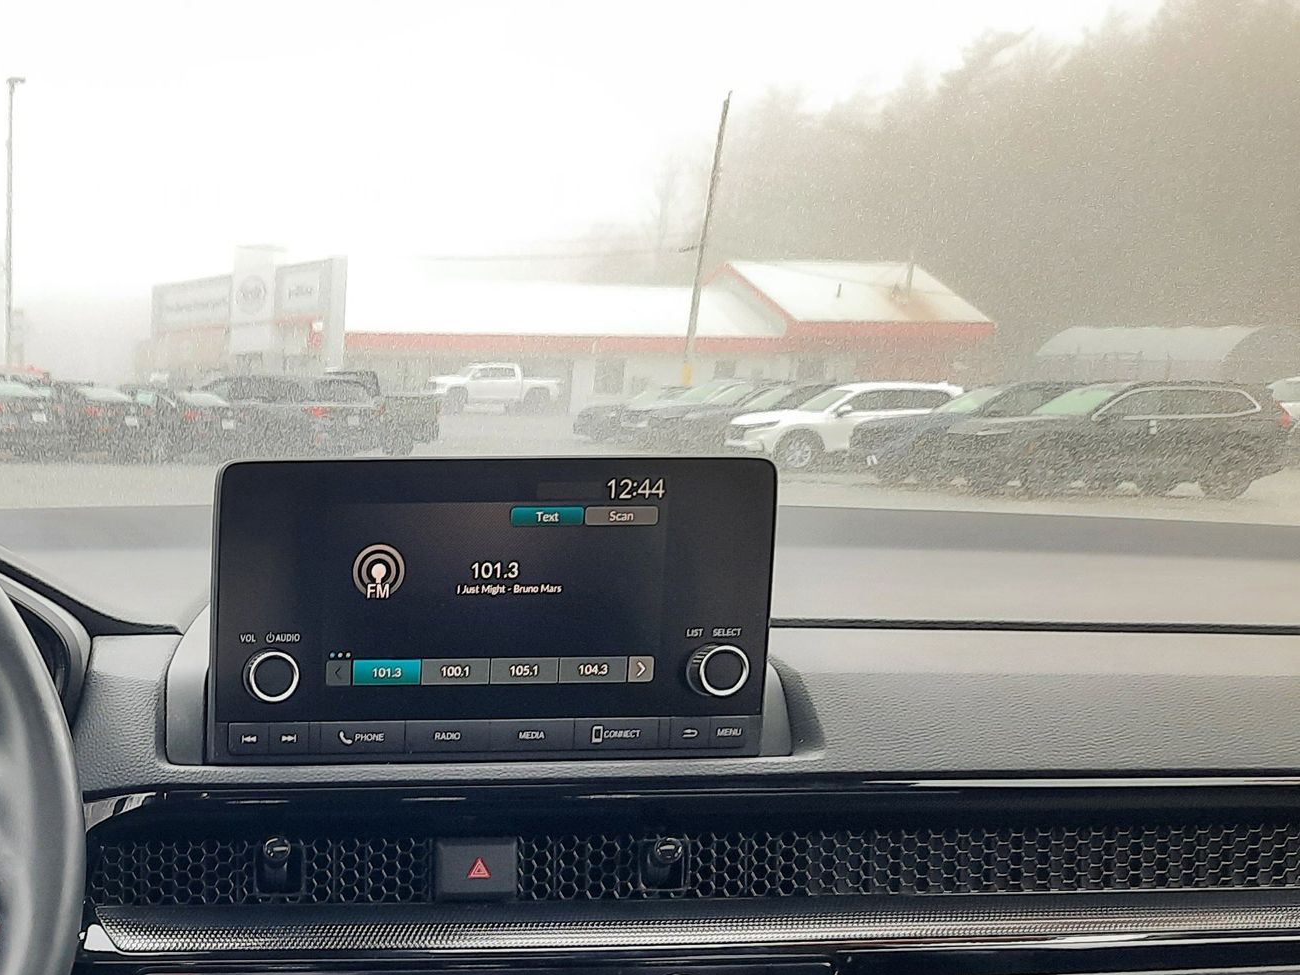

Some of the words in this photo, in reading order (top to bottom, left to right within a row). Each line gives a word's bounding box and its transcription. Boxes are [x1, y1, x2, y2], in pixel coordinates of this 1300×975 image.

[606, 478, 665, 499] 12:44
[536, 511, 559, 522] Text
[609, 510, 634, 522] Scan
[471, 562, 519, 579] 101.3
[366, 583, 390, 599] FM
[462, 584, 480, 595] Just
[481, 585, 506, 596] Might
[513, 584, 539, 594] Bruno
[540, 584, 562, 594] Mars
[240, 634, 256, 643] VOL
[275, 633, 300, 643] AUDIO
[686, 628, 704, 637] LIST
[712, 628, 741, 637] SELECT
[372, 667, 402, 678] 101.3
[440, 666, 470, 677] 100.1
[509, 665, 539, 676] 105.1
[578, 664, 608, 676] 104.3
[354, 733, 384, 742] PHONE
[434, 732, 461, 741] RADIO
[519, 731, 545, 740] MEDIA
[603, 729, 641, 739] CONNECT
[717, 728, 742, 737] MENU
